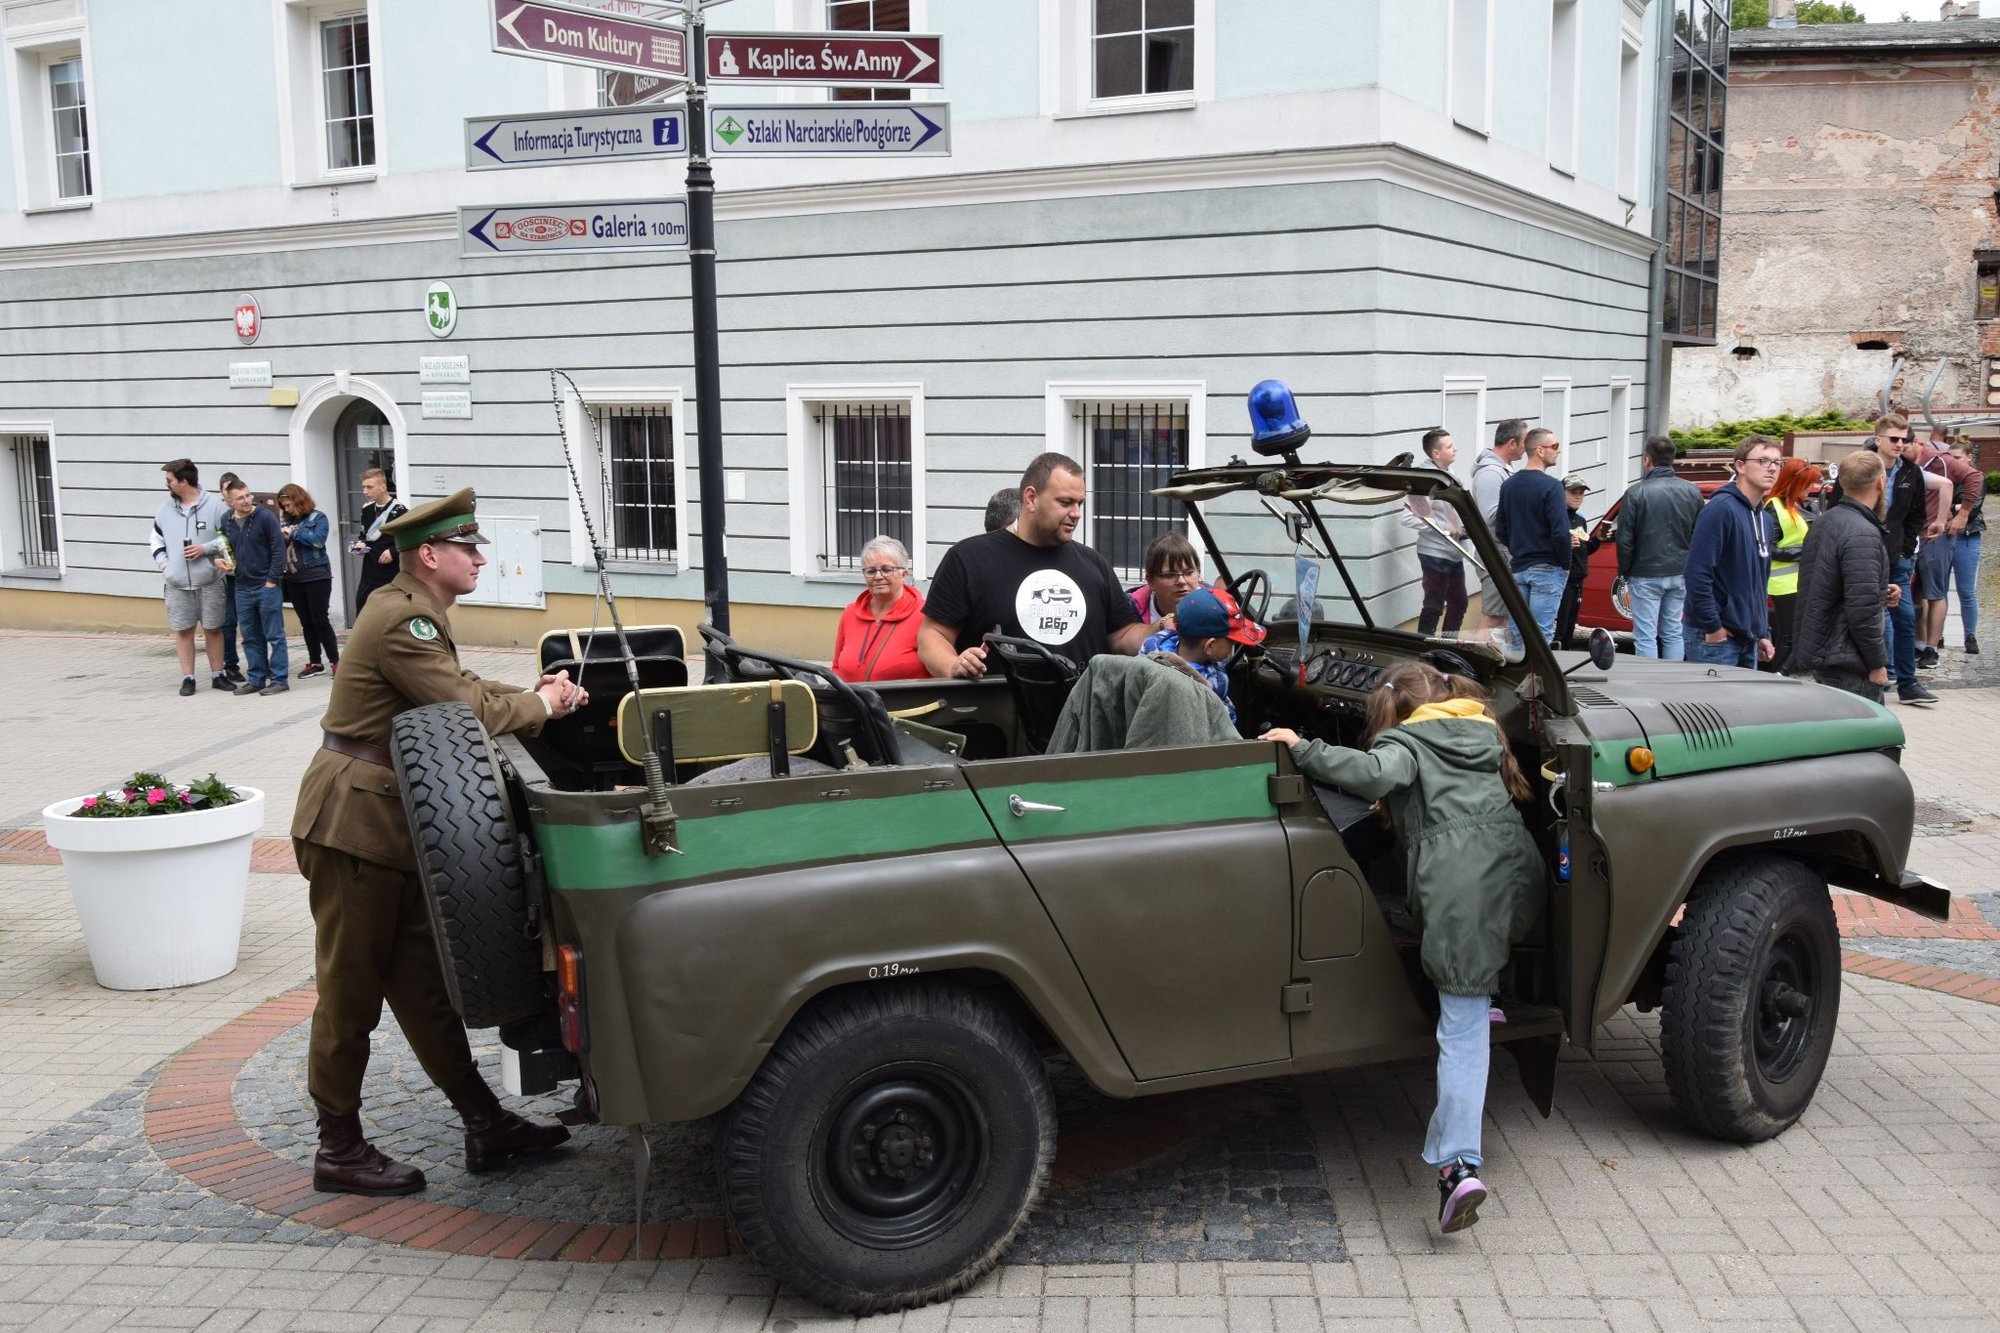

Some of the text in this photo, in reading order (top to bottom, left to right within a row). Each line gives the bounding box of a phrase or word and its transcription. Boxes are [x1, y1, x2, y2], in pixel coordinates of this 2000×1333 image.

[544, 19, 643, 64] Dom Kultury
[748, 47, 816, 76] Kaplica
[514, 126, 643, 154] Informacja Turystyczna
[747, 119, 911, 149] Szlaki Narciarskie/Podgórze
[592, 213, 685, 238] Galeria 100m
[1039, 617, 1068, 635] 126p
